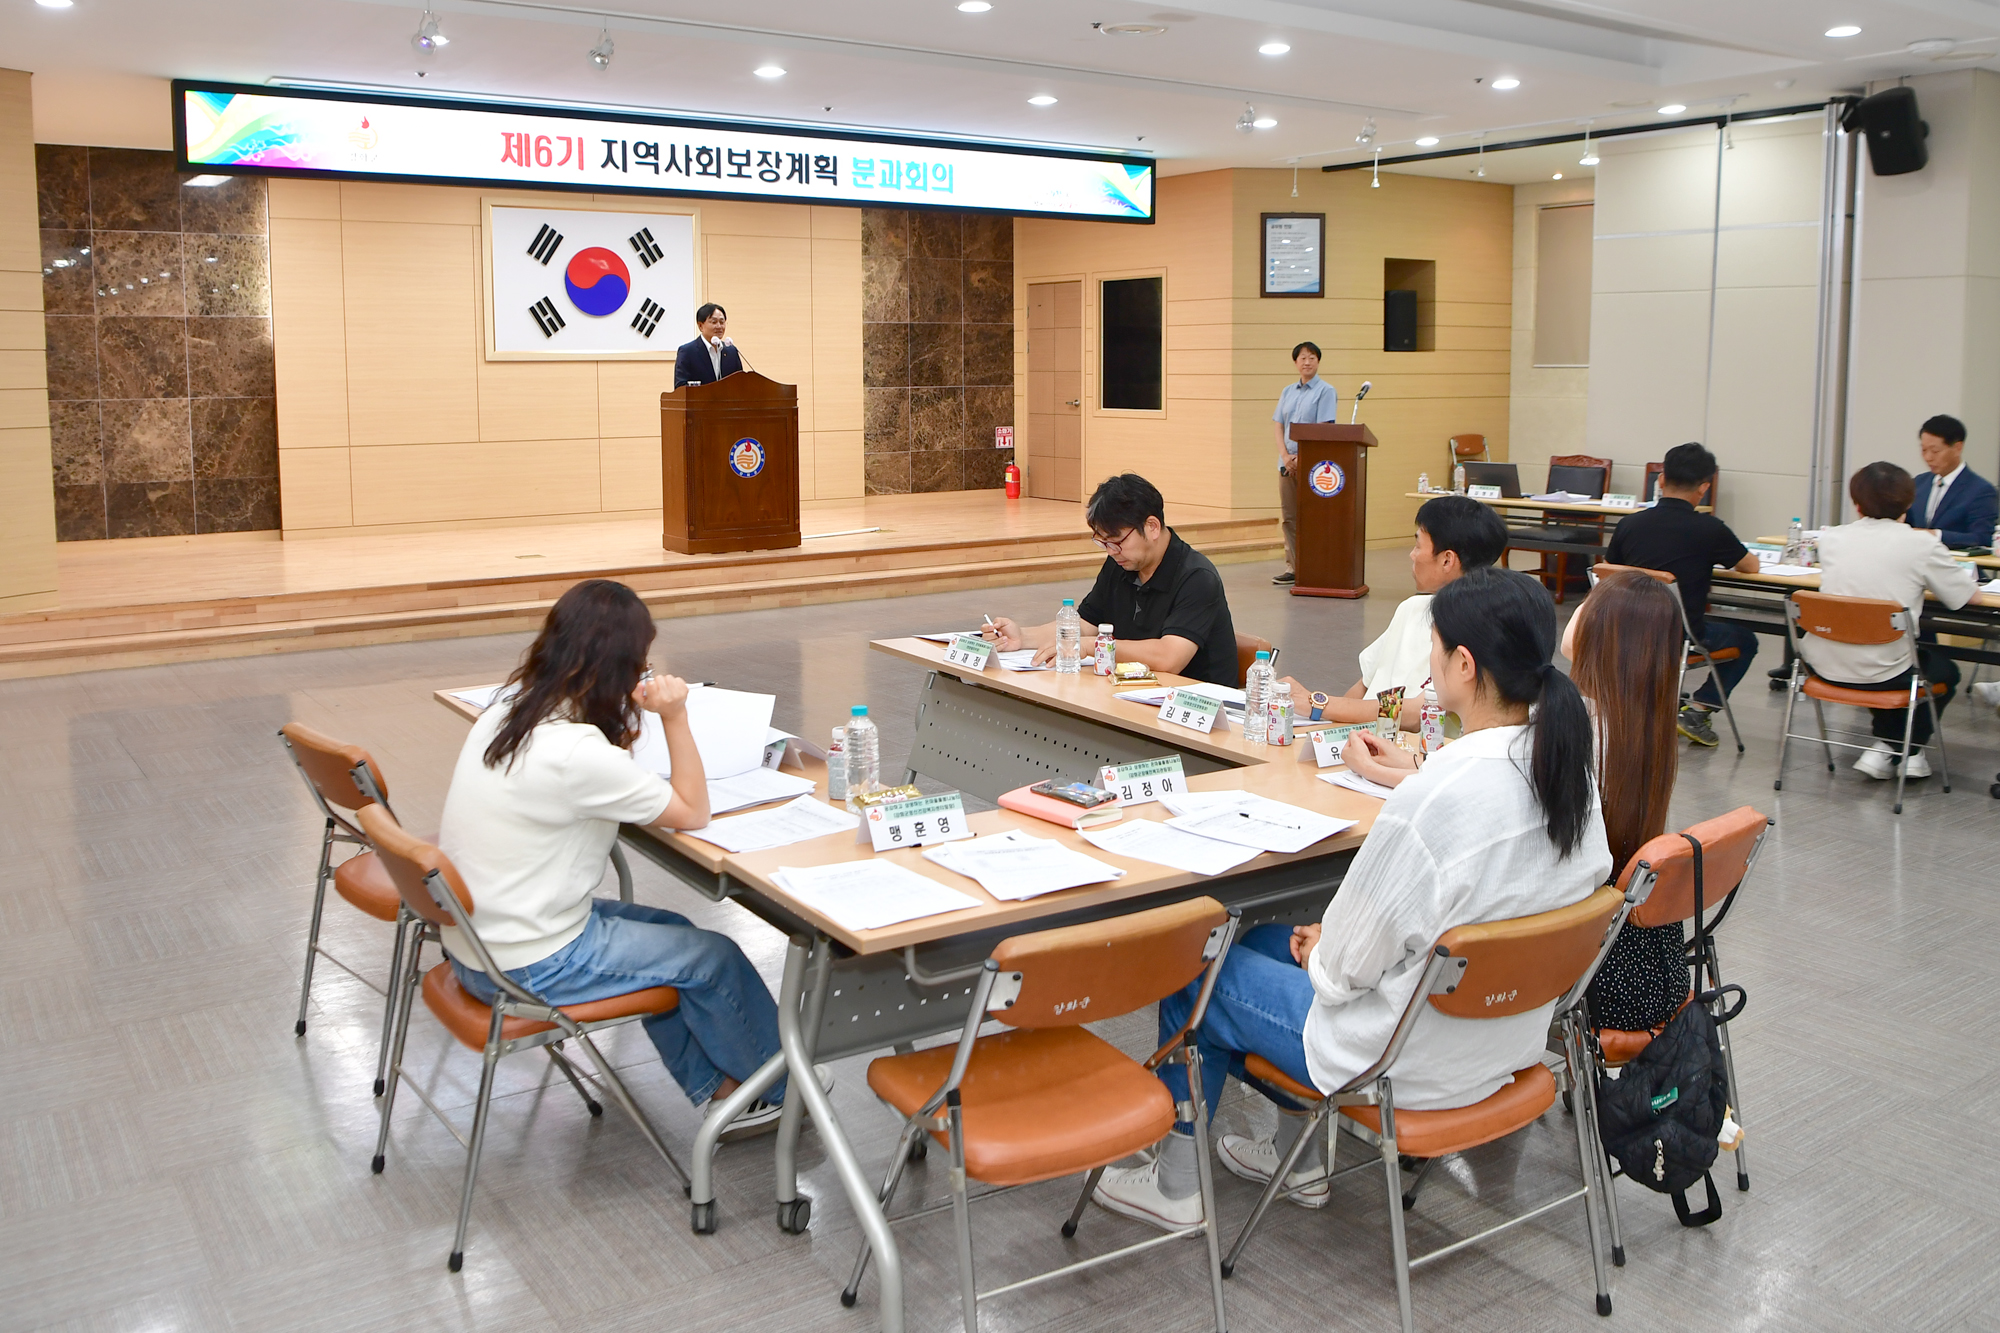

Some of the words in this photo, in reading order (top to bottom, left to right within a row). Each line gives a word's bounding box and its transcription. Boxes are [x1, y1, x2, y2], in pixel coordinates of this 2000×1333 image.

[500, 132, 585, 171] 제6기
[600, 138, 838, 186] 지역사회보장계획
[852, 157, 954, 194] 분과회의
[1166, 706, 1175, 718] 김
[1181, 711, 1191, 723] 병
[1197, 716, 1206, 727] 수
[1331, 746, 1340, 760] 유
[1121, 785, 1133, 800] 김
[1142, 782, 1153, 796] 정
[1162, 778, 1173, 792] 아
[889, 824, 902, 842] 맹
[914, 821, 926, 838] 훈
[937, 817, 950, 833] 영
